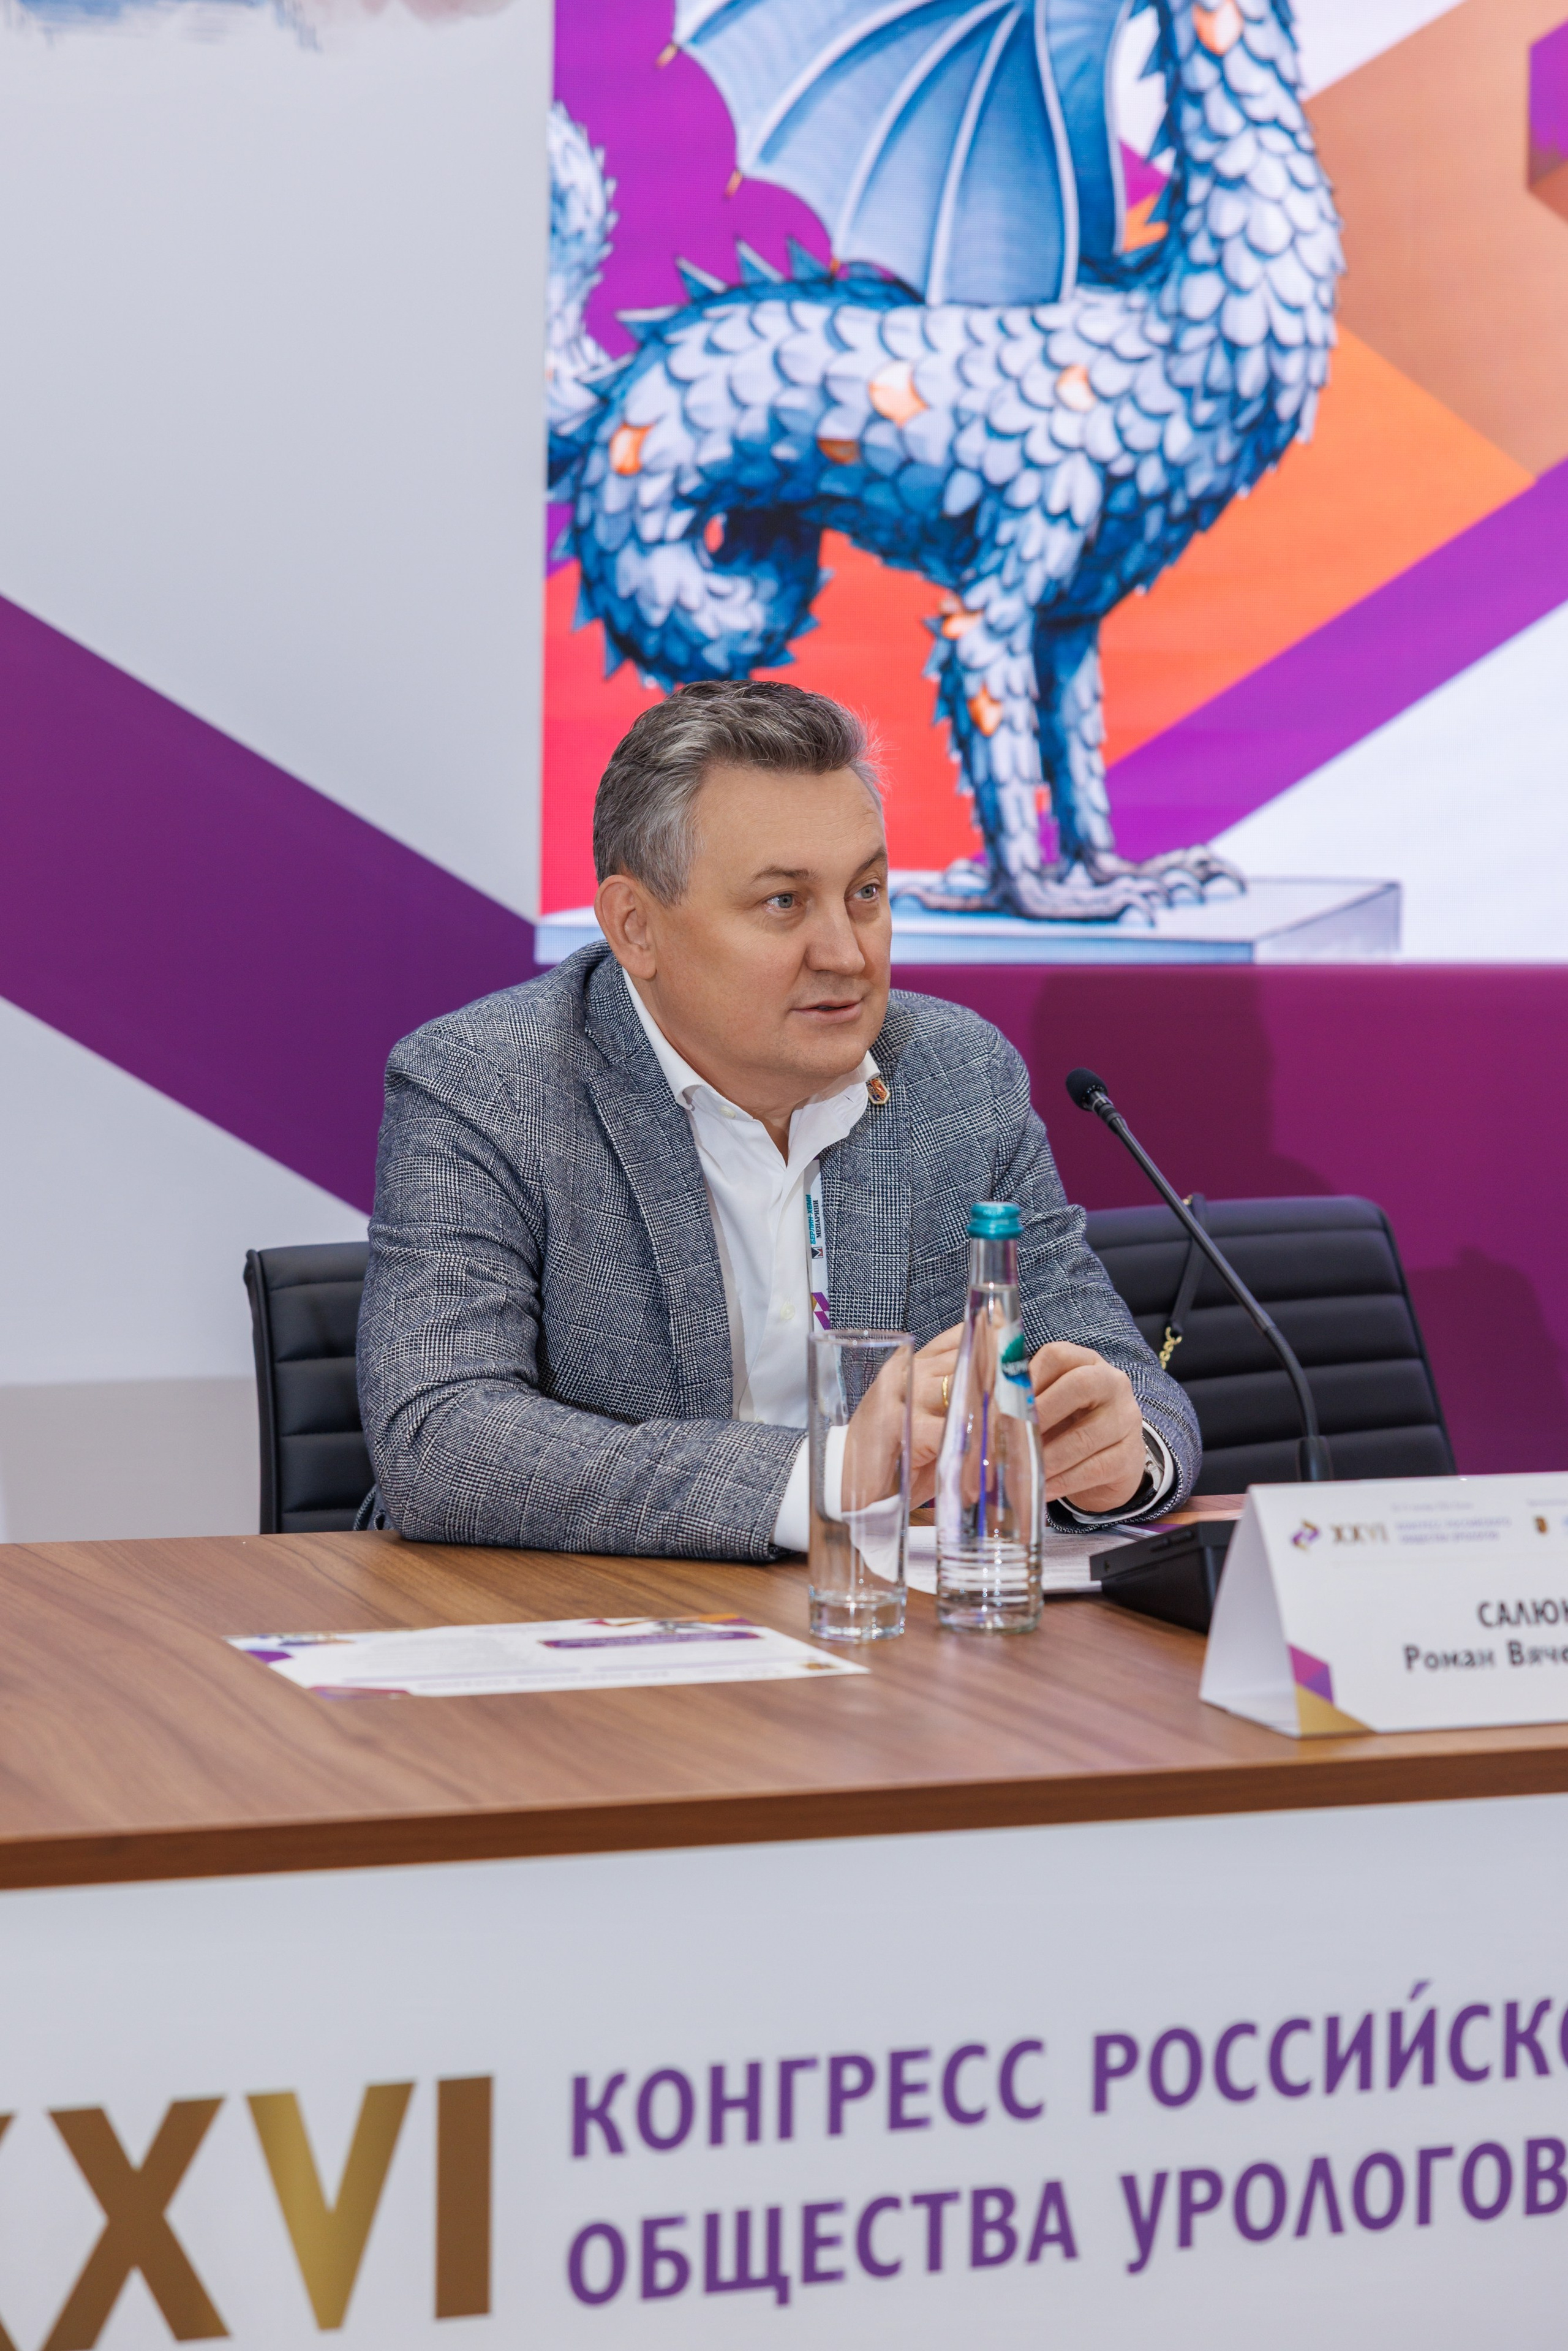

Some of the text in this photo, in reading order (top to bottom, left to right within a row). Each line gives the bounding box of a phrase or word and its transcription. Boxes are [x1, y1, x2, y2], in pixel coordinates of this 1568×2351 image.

[805, 1194, 816, 1245] БЕРЛИН-ХЕМИ
[813, 1199, 822, 1238] МЕНАРИНИ
[1403, 1644, 1496, 1672] Роман
[571, 1980, 1568, 2160] КОНГРЕСС РОССИЙСК
[0, 2074, 494, 2351] XVI
[567, 2137, 1568, 2308] ОБЩЕСТВА УРОЛОГОВ
